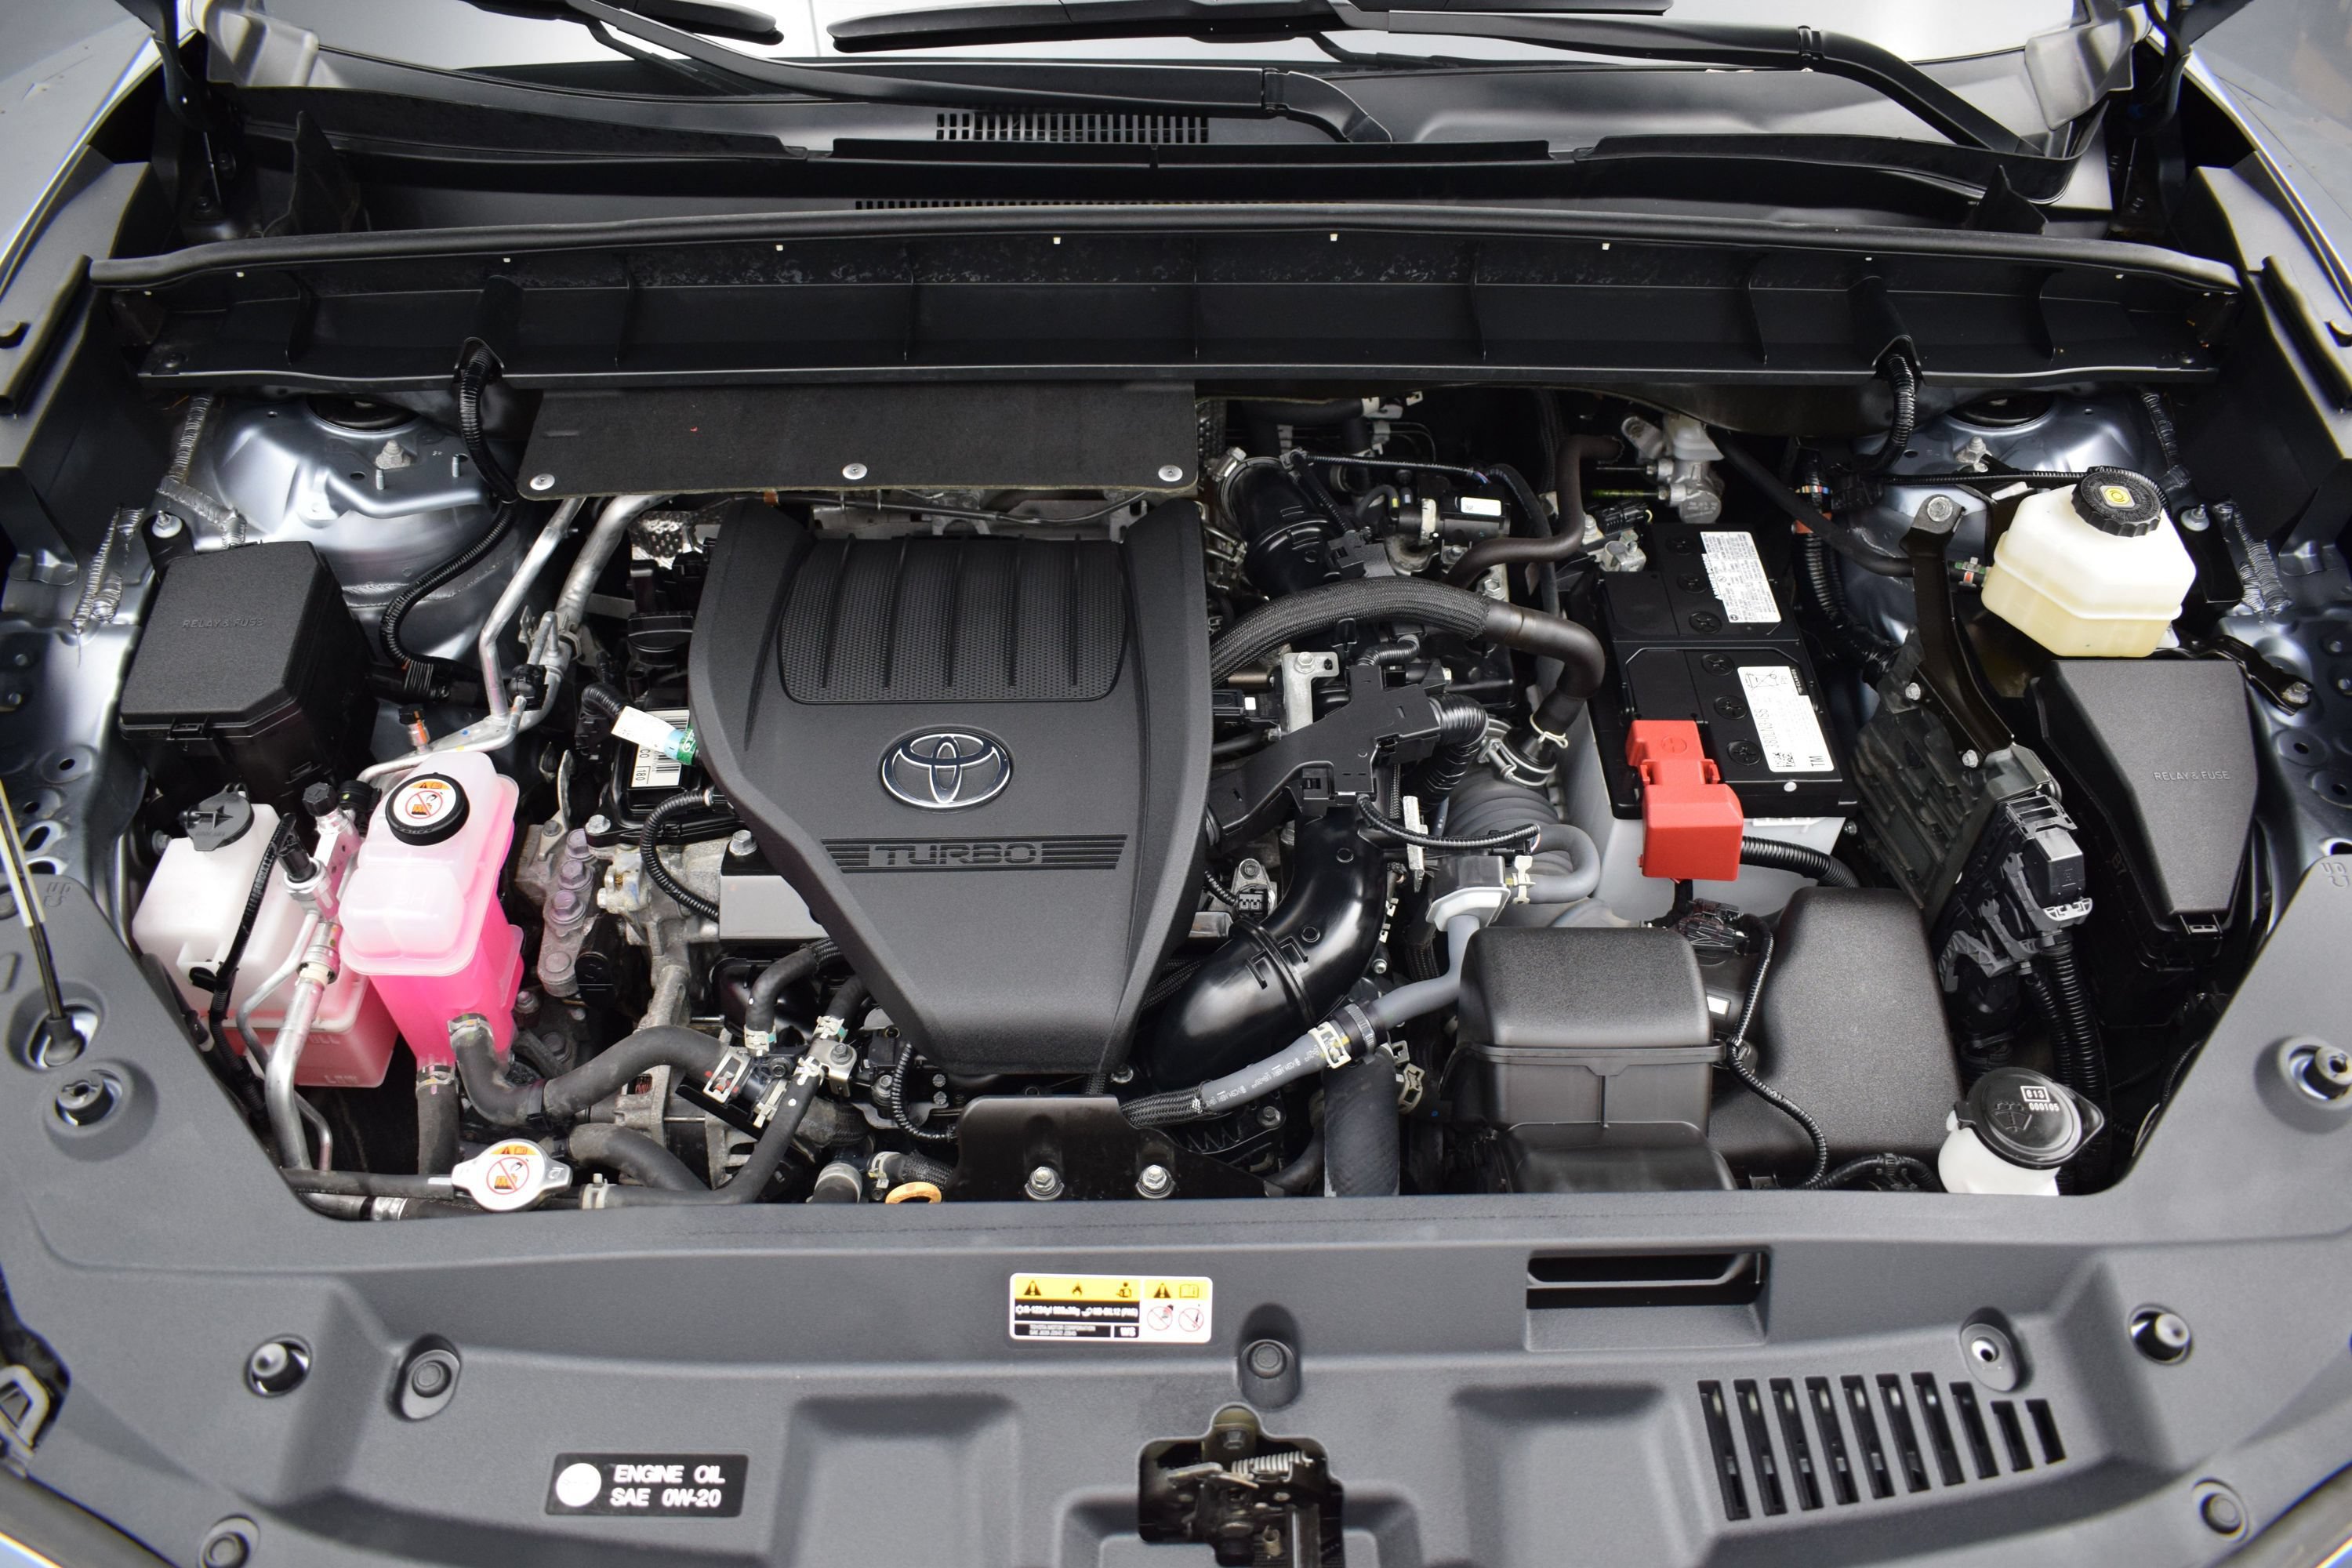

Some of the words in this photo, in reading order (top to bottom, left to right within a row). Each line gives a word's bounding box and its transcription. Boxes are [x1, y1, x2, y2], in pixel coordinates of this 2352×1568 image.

[182, 619, 219, 629] RELAY
[220, 619, 230, 627] &
[233, 617, 265, 627] FUSE
[1809, 756, 1825, 767] TM
[635, 769, 647, 781] 180
[2154, 771, 2188, 781] RELAY
[2189, 771, 2199, 780] &
[2201, 771, 2230, 779] FUSE
[874, 844, 1039, 866] TURBO
[613, 1465, 684, 1483] ENGINE
[693, 1465, 726, 1484] OIL
[609, 1487, 651, 1507] SAE
[662, 1488, 722, 1508] 0W-20
